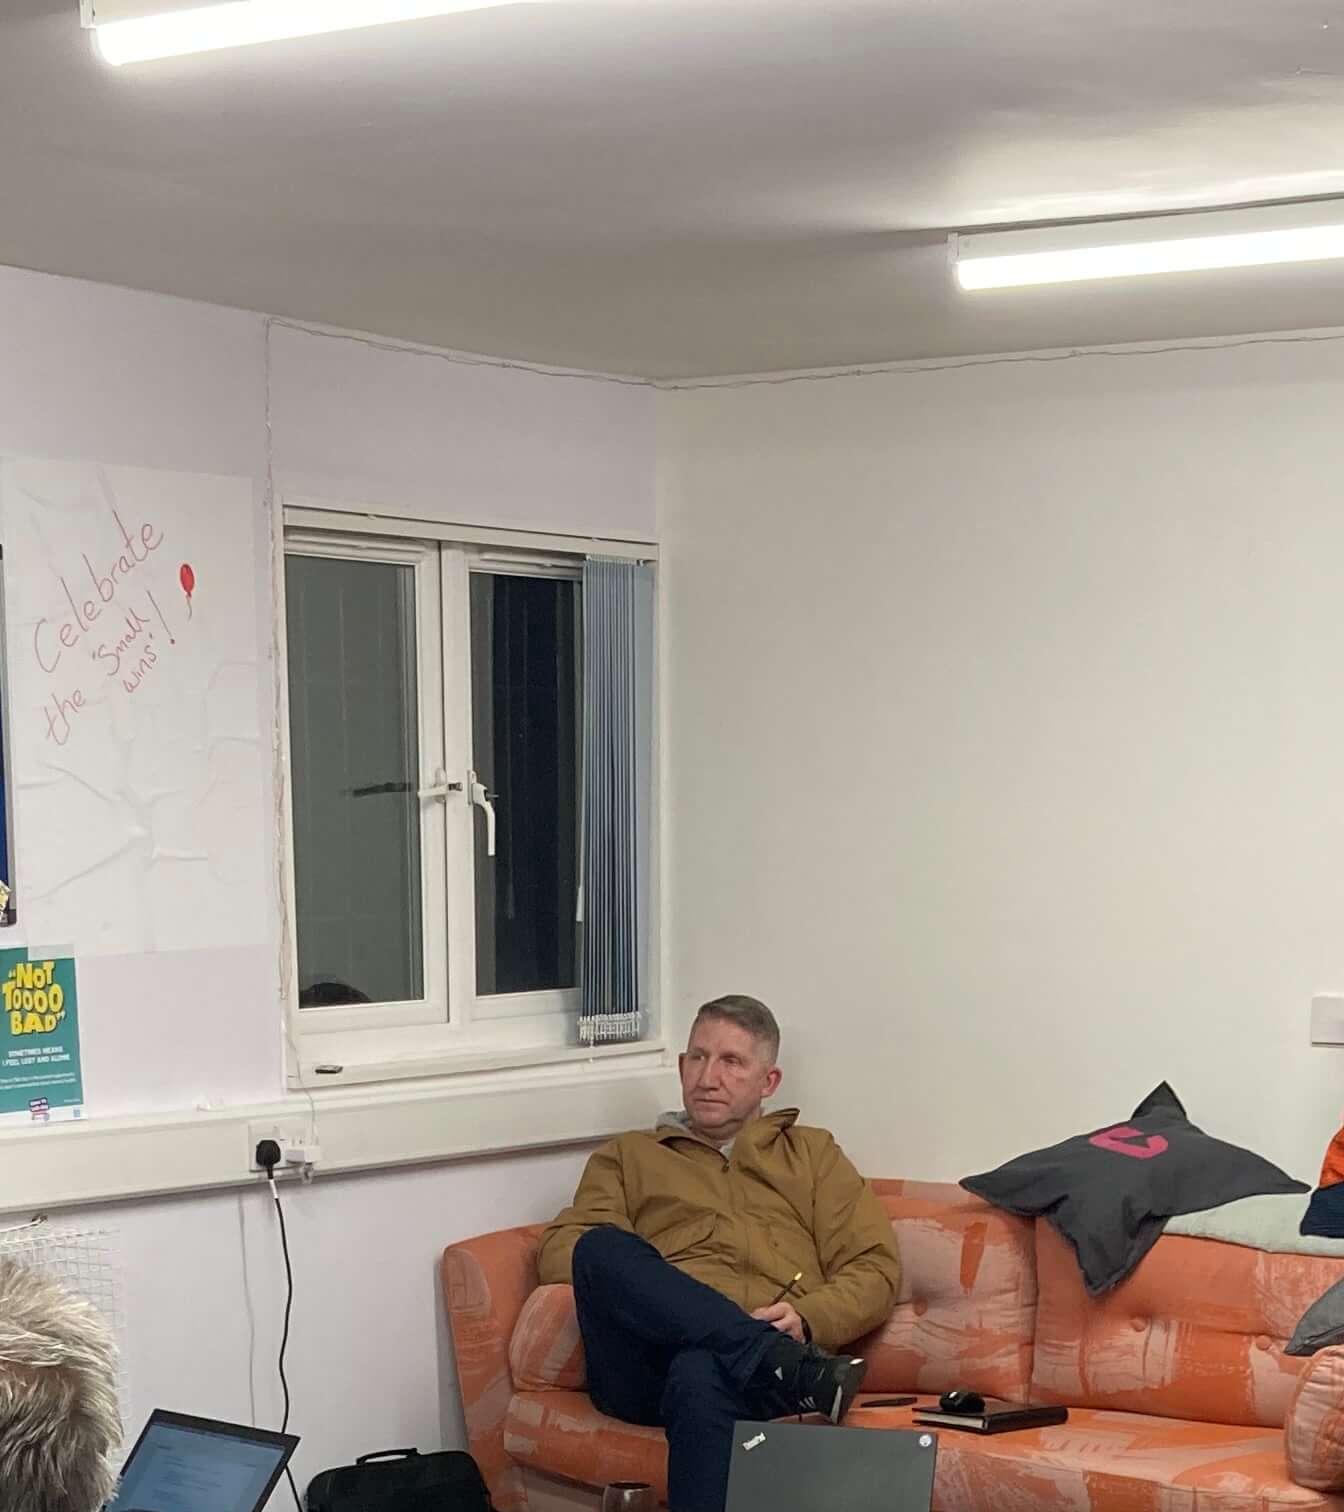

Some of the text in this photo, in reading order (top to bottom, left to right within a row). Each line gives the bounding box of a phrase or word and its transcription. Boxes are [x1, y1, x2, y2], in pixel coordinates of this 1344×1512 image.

[34, 511, 165, 673] Celebrate
[44, 688, 87, 746] the
[2, 983, 63, 1013] TOOOO
[8, 1046, 63, 1058] SOMETIMES MEANS
[21, 1057, 35, 1065] LOST
[37, 1056, 50, 1064] AND
